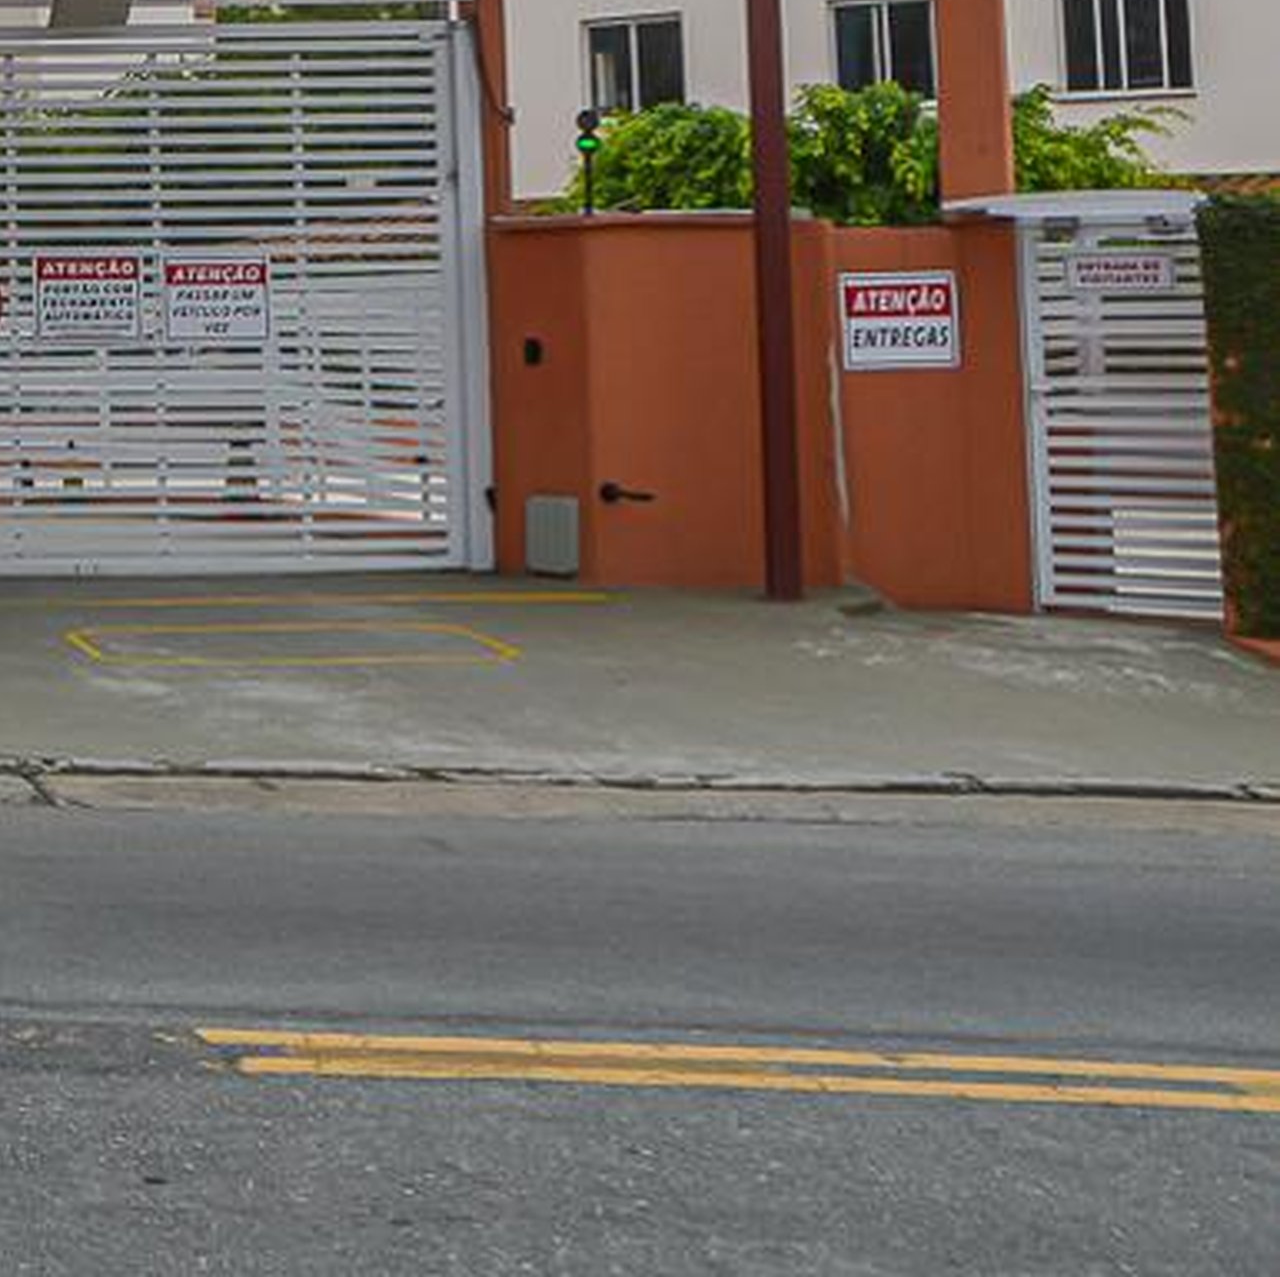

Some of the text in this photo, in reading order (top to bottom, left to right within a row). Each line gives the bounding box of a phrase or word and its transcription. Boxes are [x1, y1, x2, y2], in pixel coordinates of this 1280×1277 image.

[42, 259, 134, 277] ATENÇÃO
[172, 265, 260, 282] ATENÇÃO
[103, 282, 133, 294] COM
[852, 286, 946, 315] ATENÇÃO
[853, 326, 949, 348] ENTREGAS
